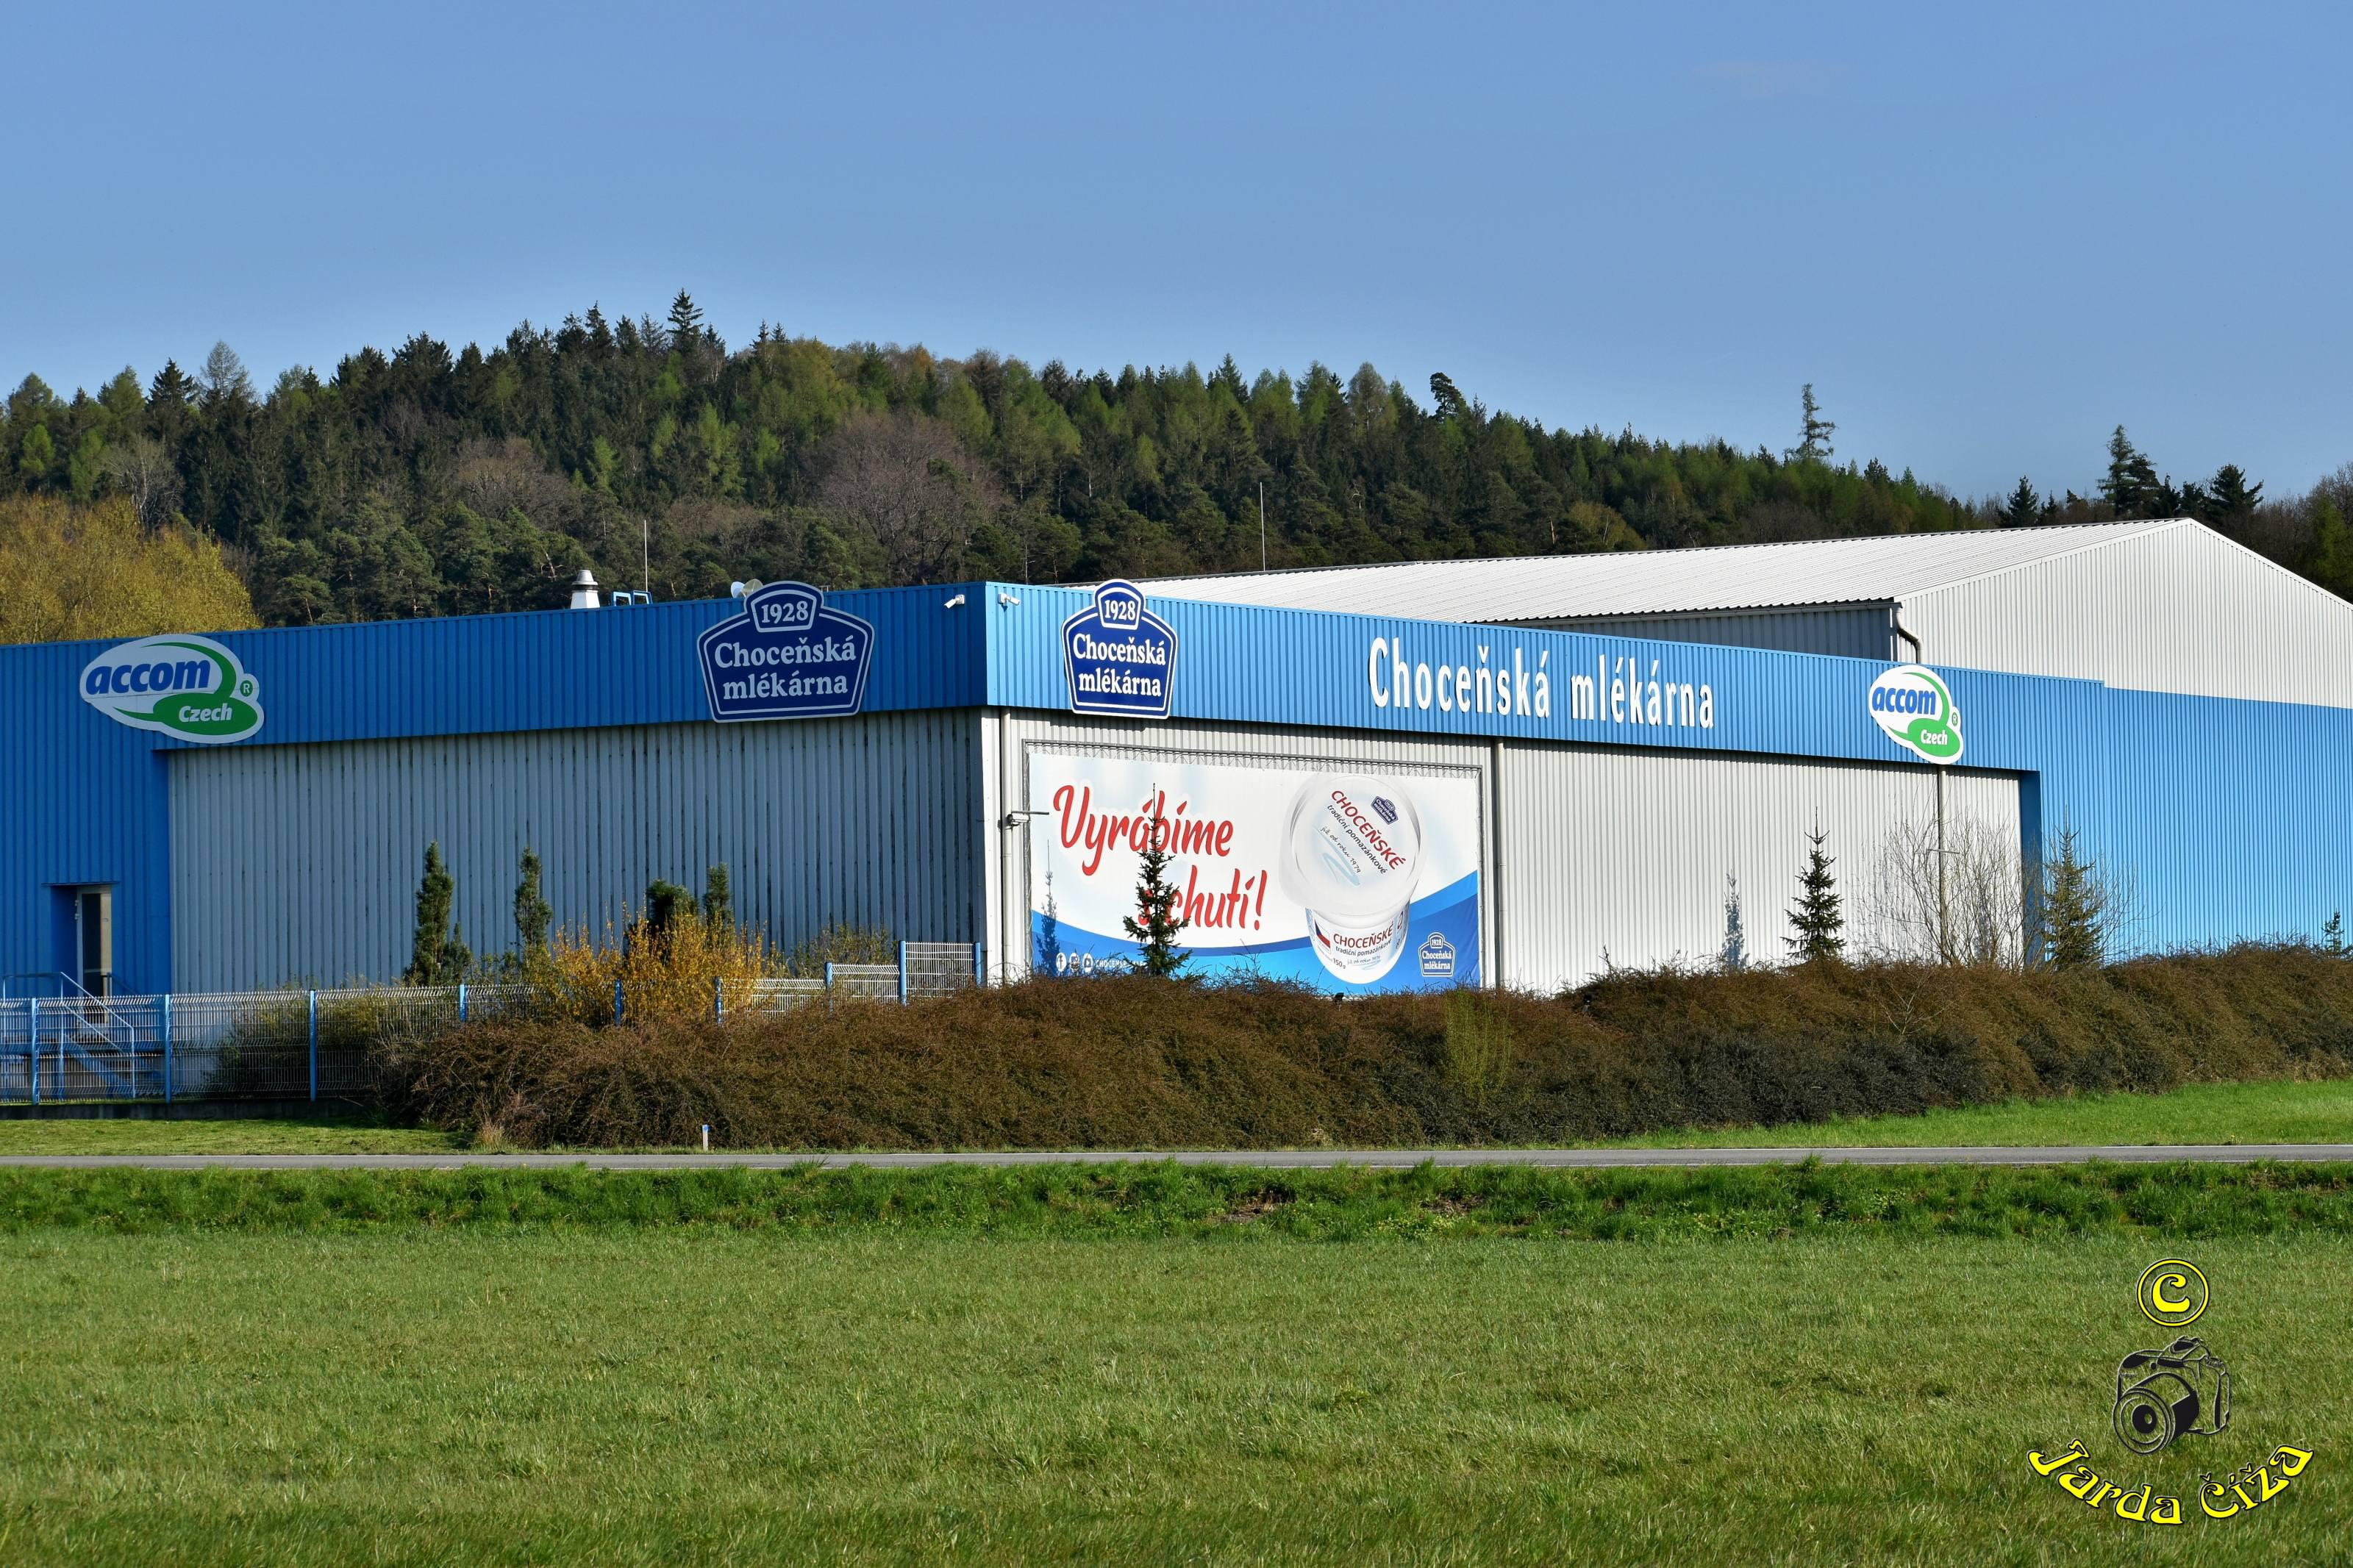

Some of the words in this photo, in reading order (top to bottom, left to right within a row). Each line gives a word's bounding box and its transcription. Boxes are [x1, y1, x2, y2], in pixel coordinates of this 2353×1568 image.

[760, 601, 809, 624] 1928
[1104, 599, 1136, 621] 1928
[714, 634, 857, 668] Choceňská
[1073, 633, 1166, 666] Choceňská
[85, 659, 211, 695] accom
[723, 670, 849, 700] mlékárna
[1078, 667, 1162, 697] mlékárna
[1368, 637, 1550, 718] Choceňská
[1571, 654, 1714, 729] mlékárna
[179, 703, 232, 723] Czech
[1871, 687, 1936, 715] accom
[1920, 729, 1948, 745] Czech
[1053, 784, 1234, 876] Vyrábíme
[1327, 804, 1350, 829] tradiční
[1346, 828, 1388, 874] pomazánkové
[1331, 790, 1407, 870] CHOCEŇSKÉ
[1333, 920, 1394, 949] CHOCEŇSKÉ
[1332, 957, 1343, 967] 150
[1335, 946, 1357, 956] tradiční
